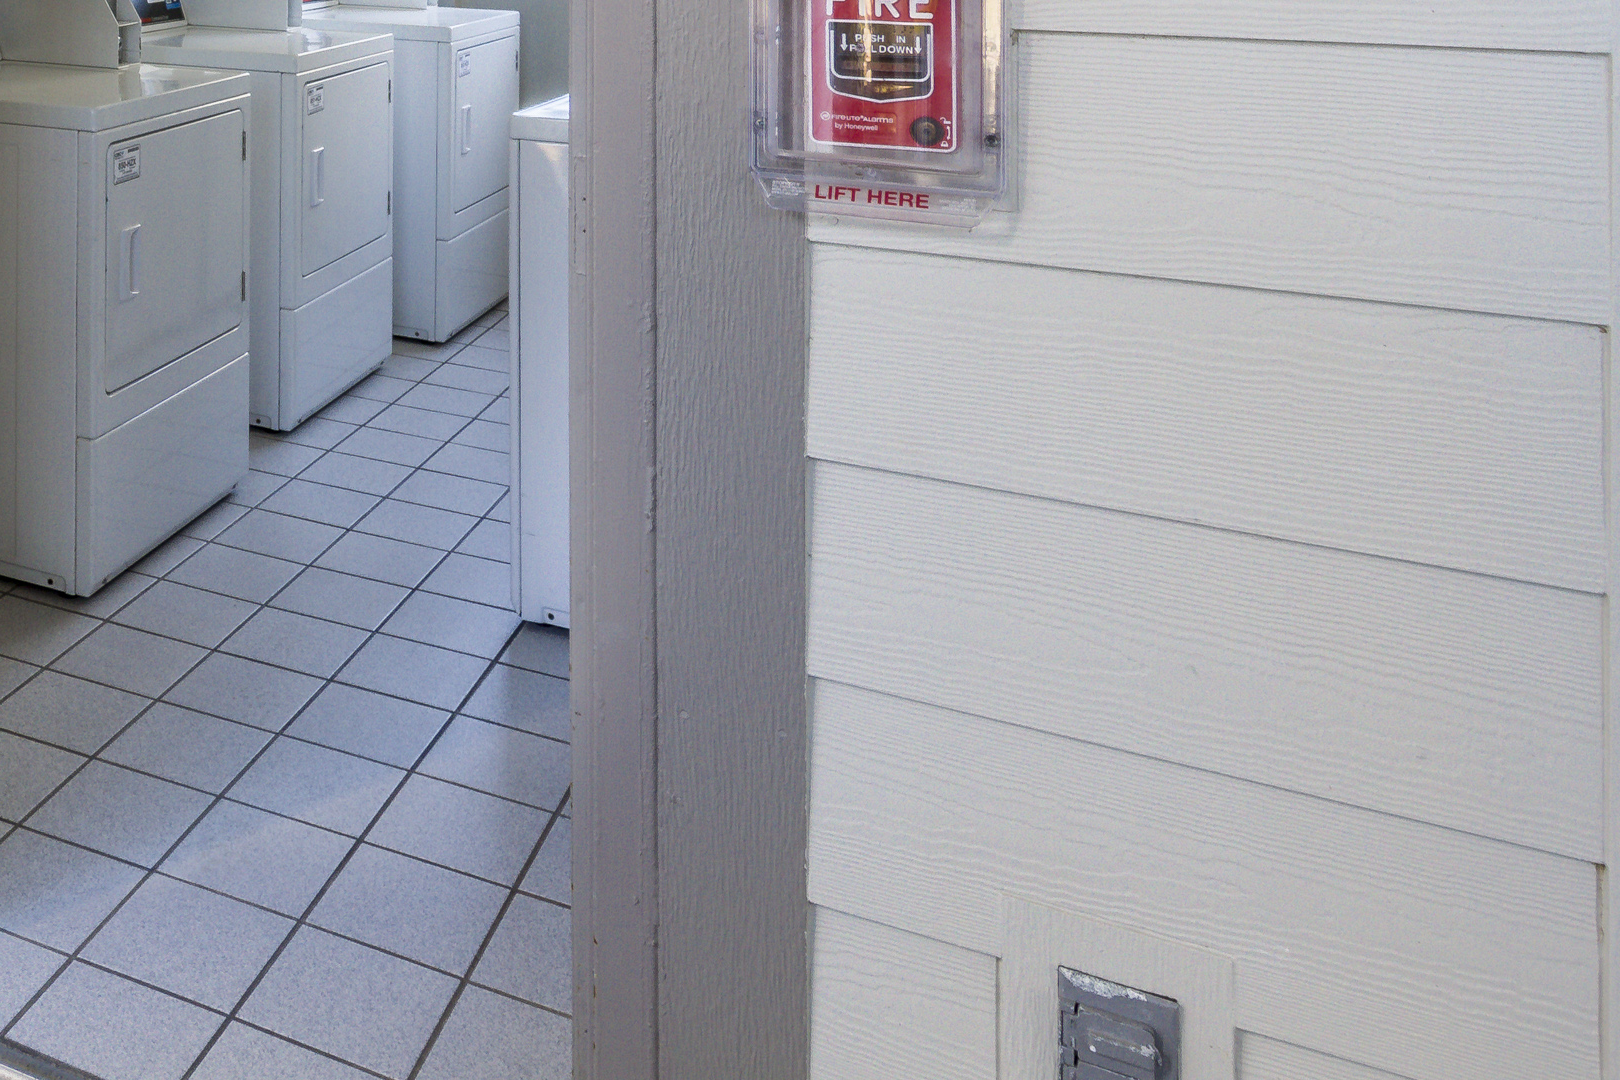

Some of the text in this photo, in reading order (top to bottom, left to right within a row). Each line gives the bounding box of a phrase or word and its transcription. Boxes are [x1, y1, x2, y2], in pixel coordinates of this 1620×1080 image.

[854, 33, 906, 43] PSH IN
[879, 45, 913, 54] DOWN
[834, 122, 879, 131] by Honeywell
[814, 184, 861, 202] LIFT
[867, 188, 929, 209] HERE
